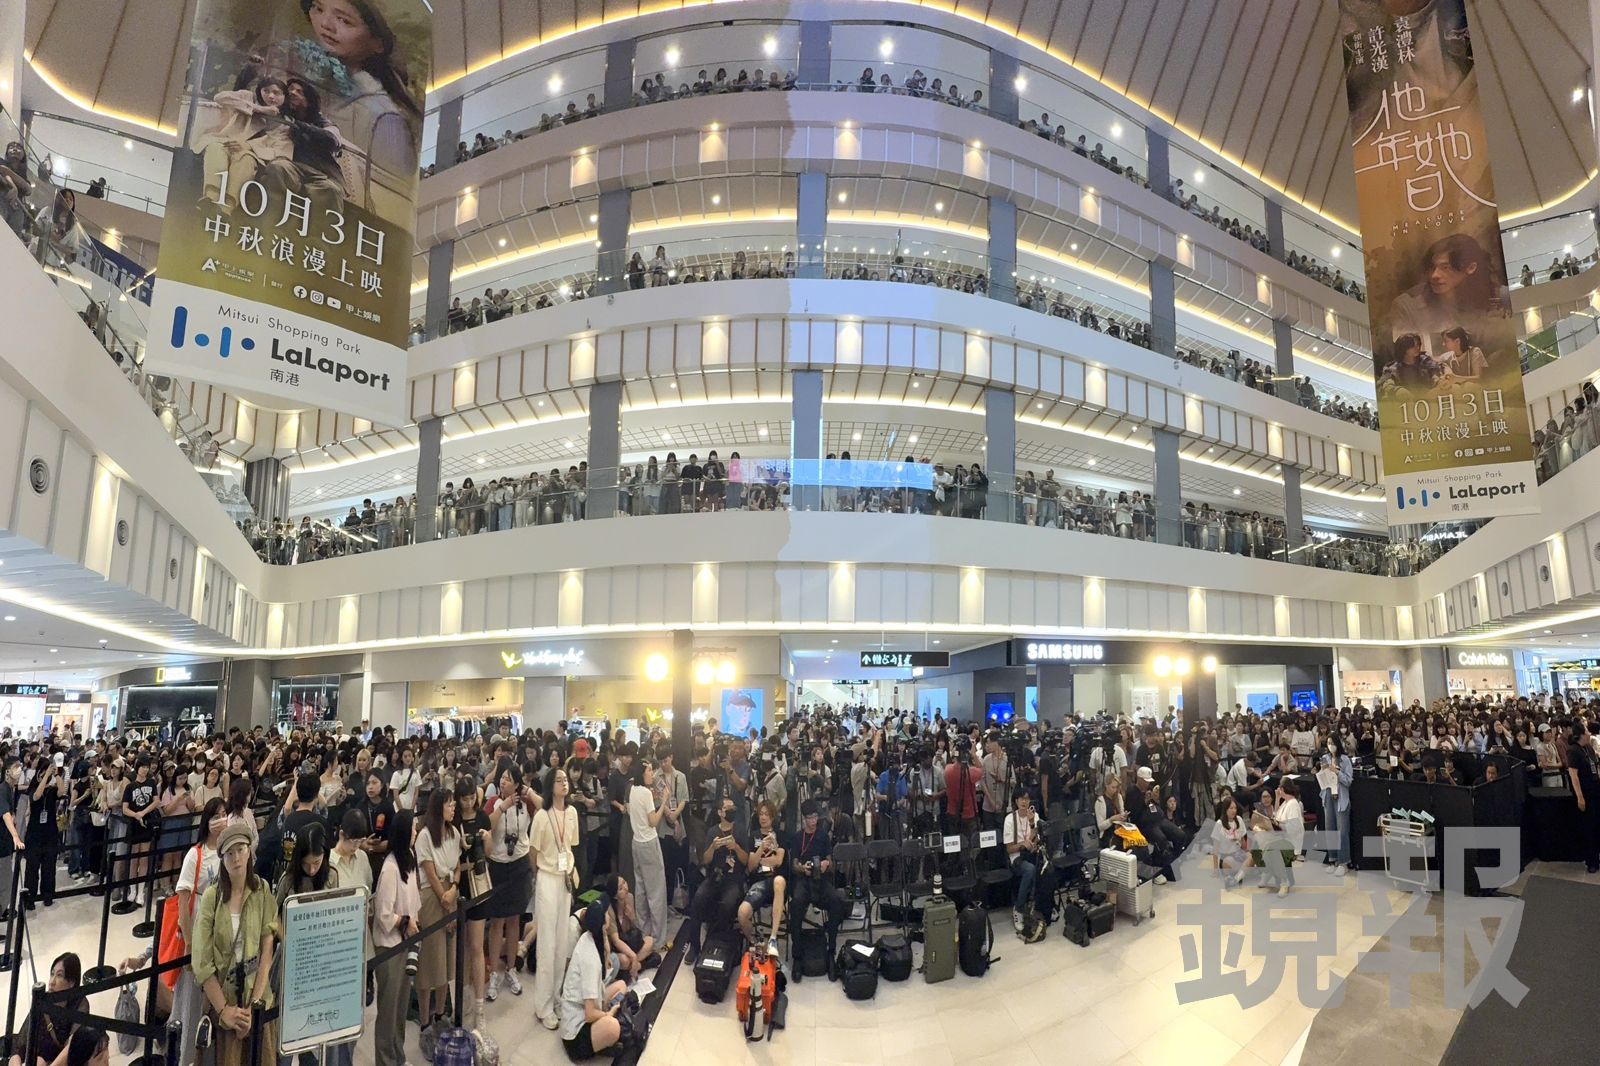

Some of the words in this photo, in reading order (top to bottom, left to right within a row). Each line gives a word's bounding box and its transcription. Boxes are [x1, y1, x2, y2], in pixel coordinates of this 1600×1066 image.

[1367, 25, 1390, 73] 許光漢
[213, 170, 386, 266] 10月3日
[204, 214, 384, 298] 中秋浪漫上映
[217, 304, 260, 325] Mitsui
[267, 316, 329, 347] Shopping
[336, 337, 361, 355] Park
[269, 367, 300, 387] 南港
[271, 338, 391, 391] LaLaport
[1399, 388, 1505, 425] 10月3日
[1400, 418, 1510, 447] 中秋浪漫上映
[1416, 477, 1440, 485] Mitsui
[1443, 472, 1482, 483] Shopping
[1485, 470, 1503, 479] Park
[1448, 481, 1526, 500] LaLaport
[1027, 643, 1103, 660] SAMSUNG
[1458, 651, 1487, 665] Calvin
[1487, 652, 1508, 665] Klein
